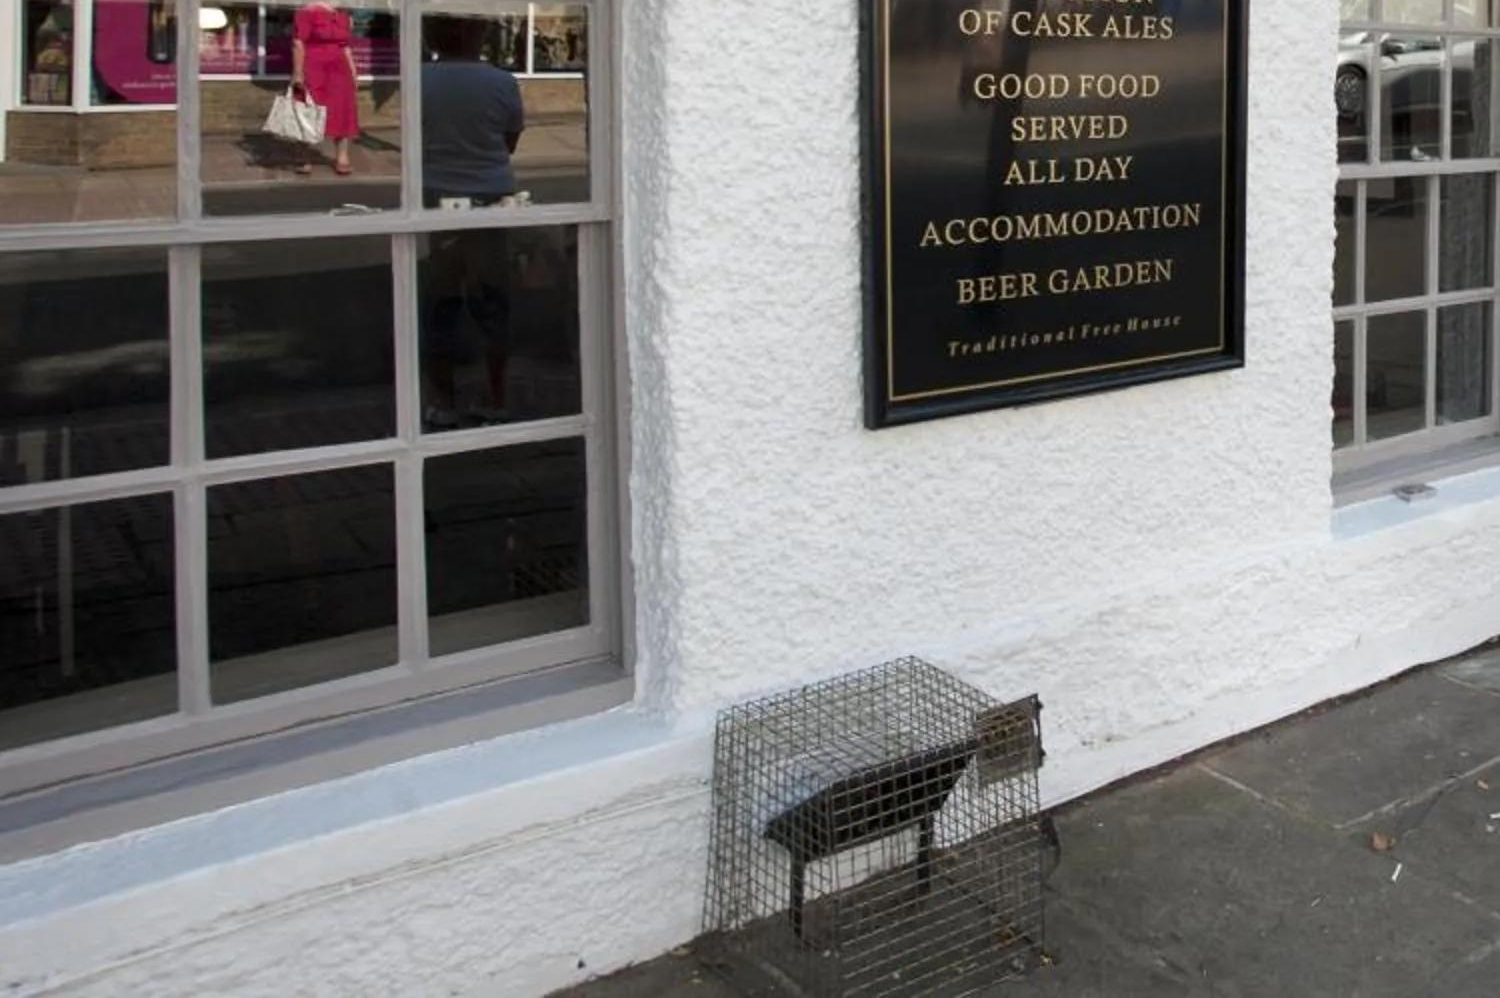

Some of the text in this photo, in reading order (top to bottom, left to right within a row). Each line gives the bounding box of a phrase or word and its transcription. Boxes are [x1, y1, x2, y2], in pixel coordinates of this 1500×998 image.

[958, 9, 1174, 40] OF CASK ALES
[973, 73, 1161, 100] GOOD FOOD
[1011, 114, 1128, 142] SERVED
[1003, 155, 1133, 186] ALL DAY
[919, 202, 1201, 247] ACCOMMODATION
[956, 258, 1174, 304] BEER GARDEN
[949, 313, 1184, 357] Traditional Free House
